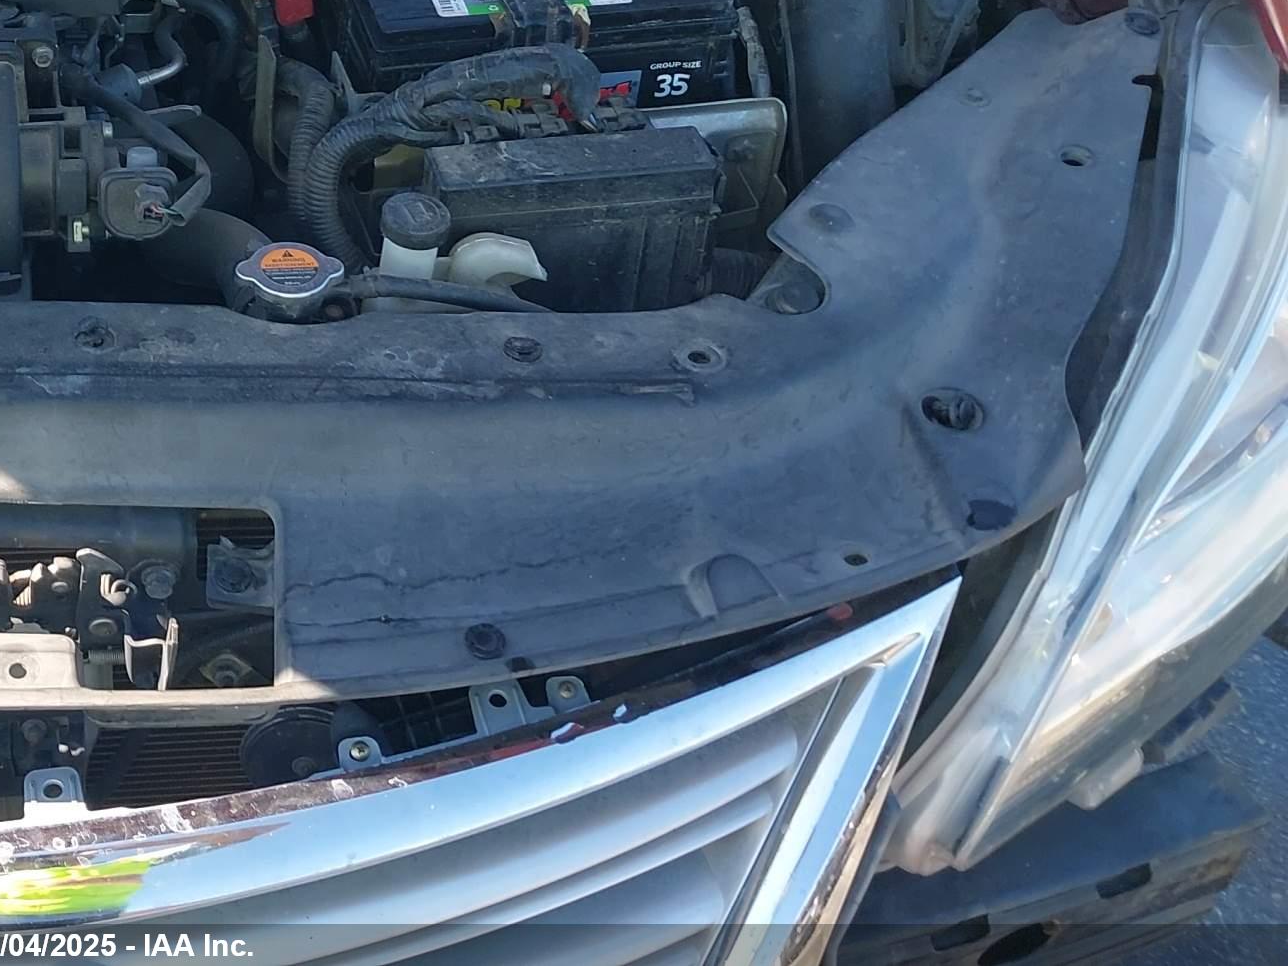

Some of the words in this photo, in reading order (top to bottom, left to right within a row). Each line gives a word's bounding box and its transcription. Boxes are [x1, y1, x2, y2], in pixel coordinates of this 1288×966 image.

[649, 61, 681, 70] GROUP
[682, 60, 702, 68] SIZE
[654, 73, 690, 98] 35
